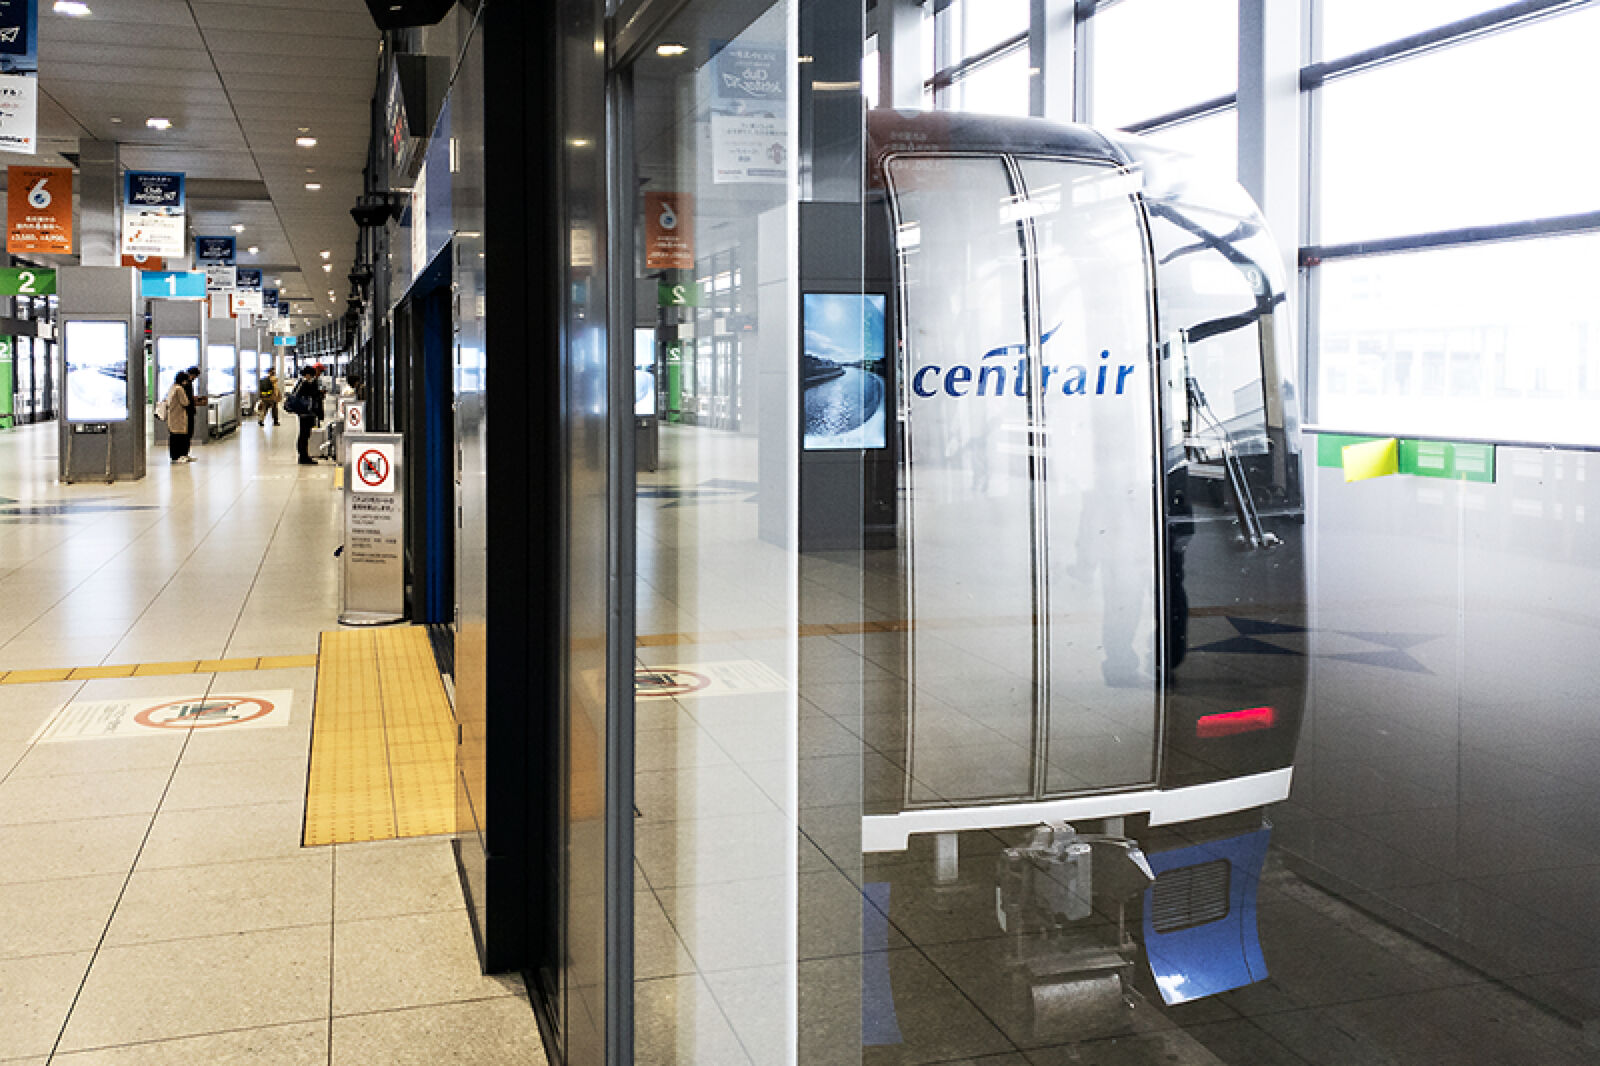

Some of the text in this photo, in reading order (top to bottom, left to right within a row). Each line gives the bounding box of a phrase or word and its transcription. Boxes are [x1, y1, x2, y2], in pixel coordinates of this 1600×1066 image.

[28, 178, 52, 209] 6
[18, 272, 36, 293] 2
[164, 274, 177, 295] 1
[912, 344, 1136, 398] centrair
